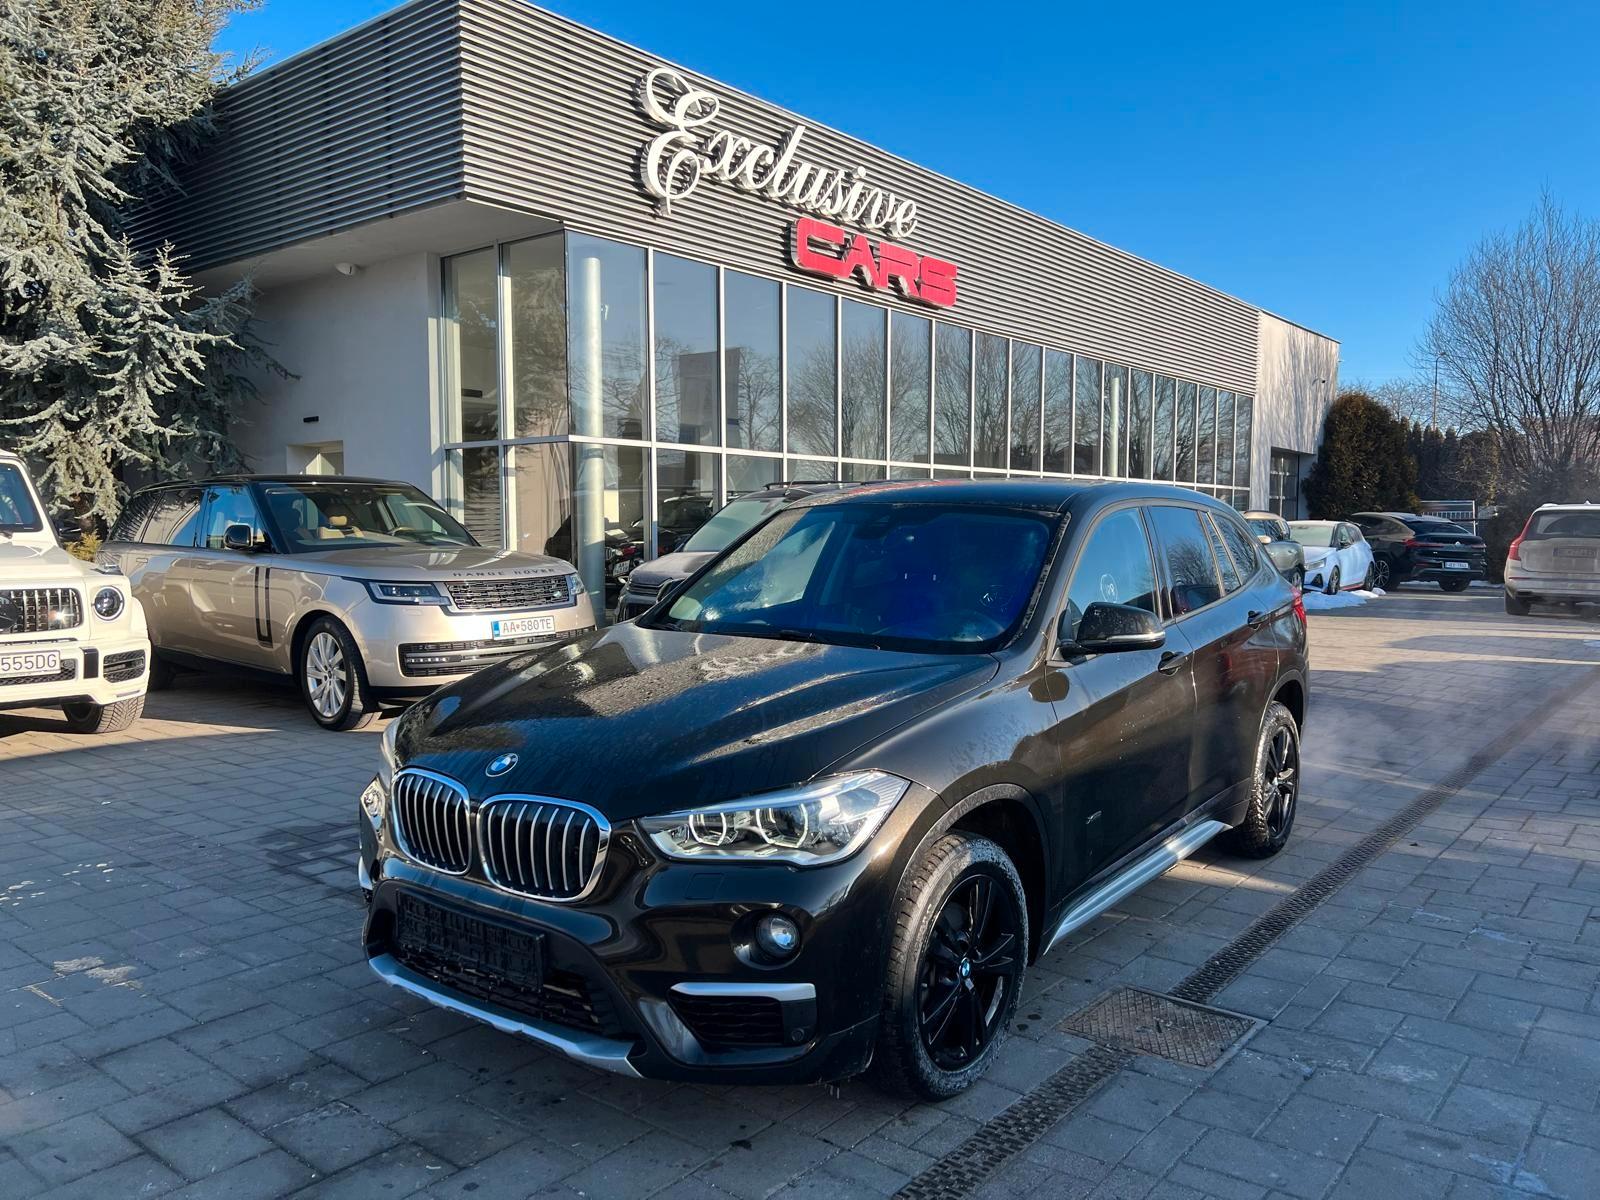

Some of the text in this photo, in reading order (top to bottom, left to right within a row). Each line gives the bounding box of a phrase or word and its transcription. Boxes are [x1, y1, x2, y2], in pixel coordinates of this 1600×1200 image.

[639, 67, 920, 238] Exclusive
[790, 216, 958, 308] CARS
[1, 654, 57, 672] 555DG
